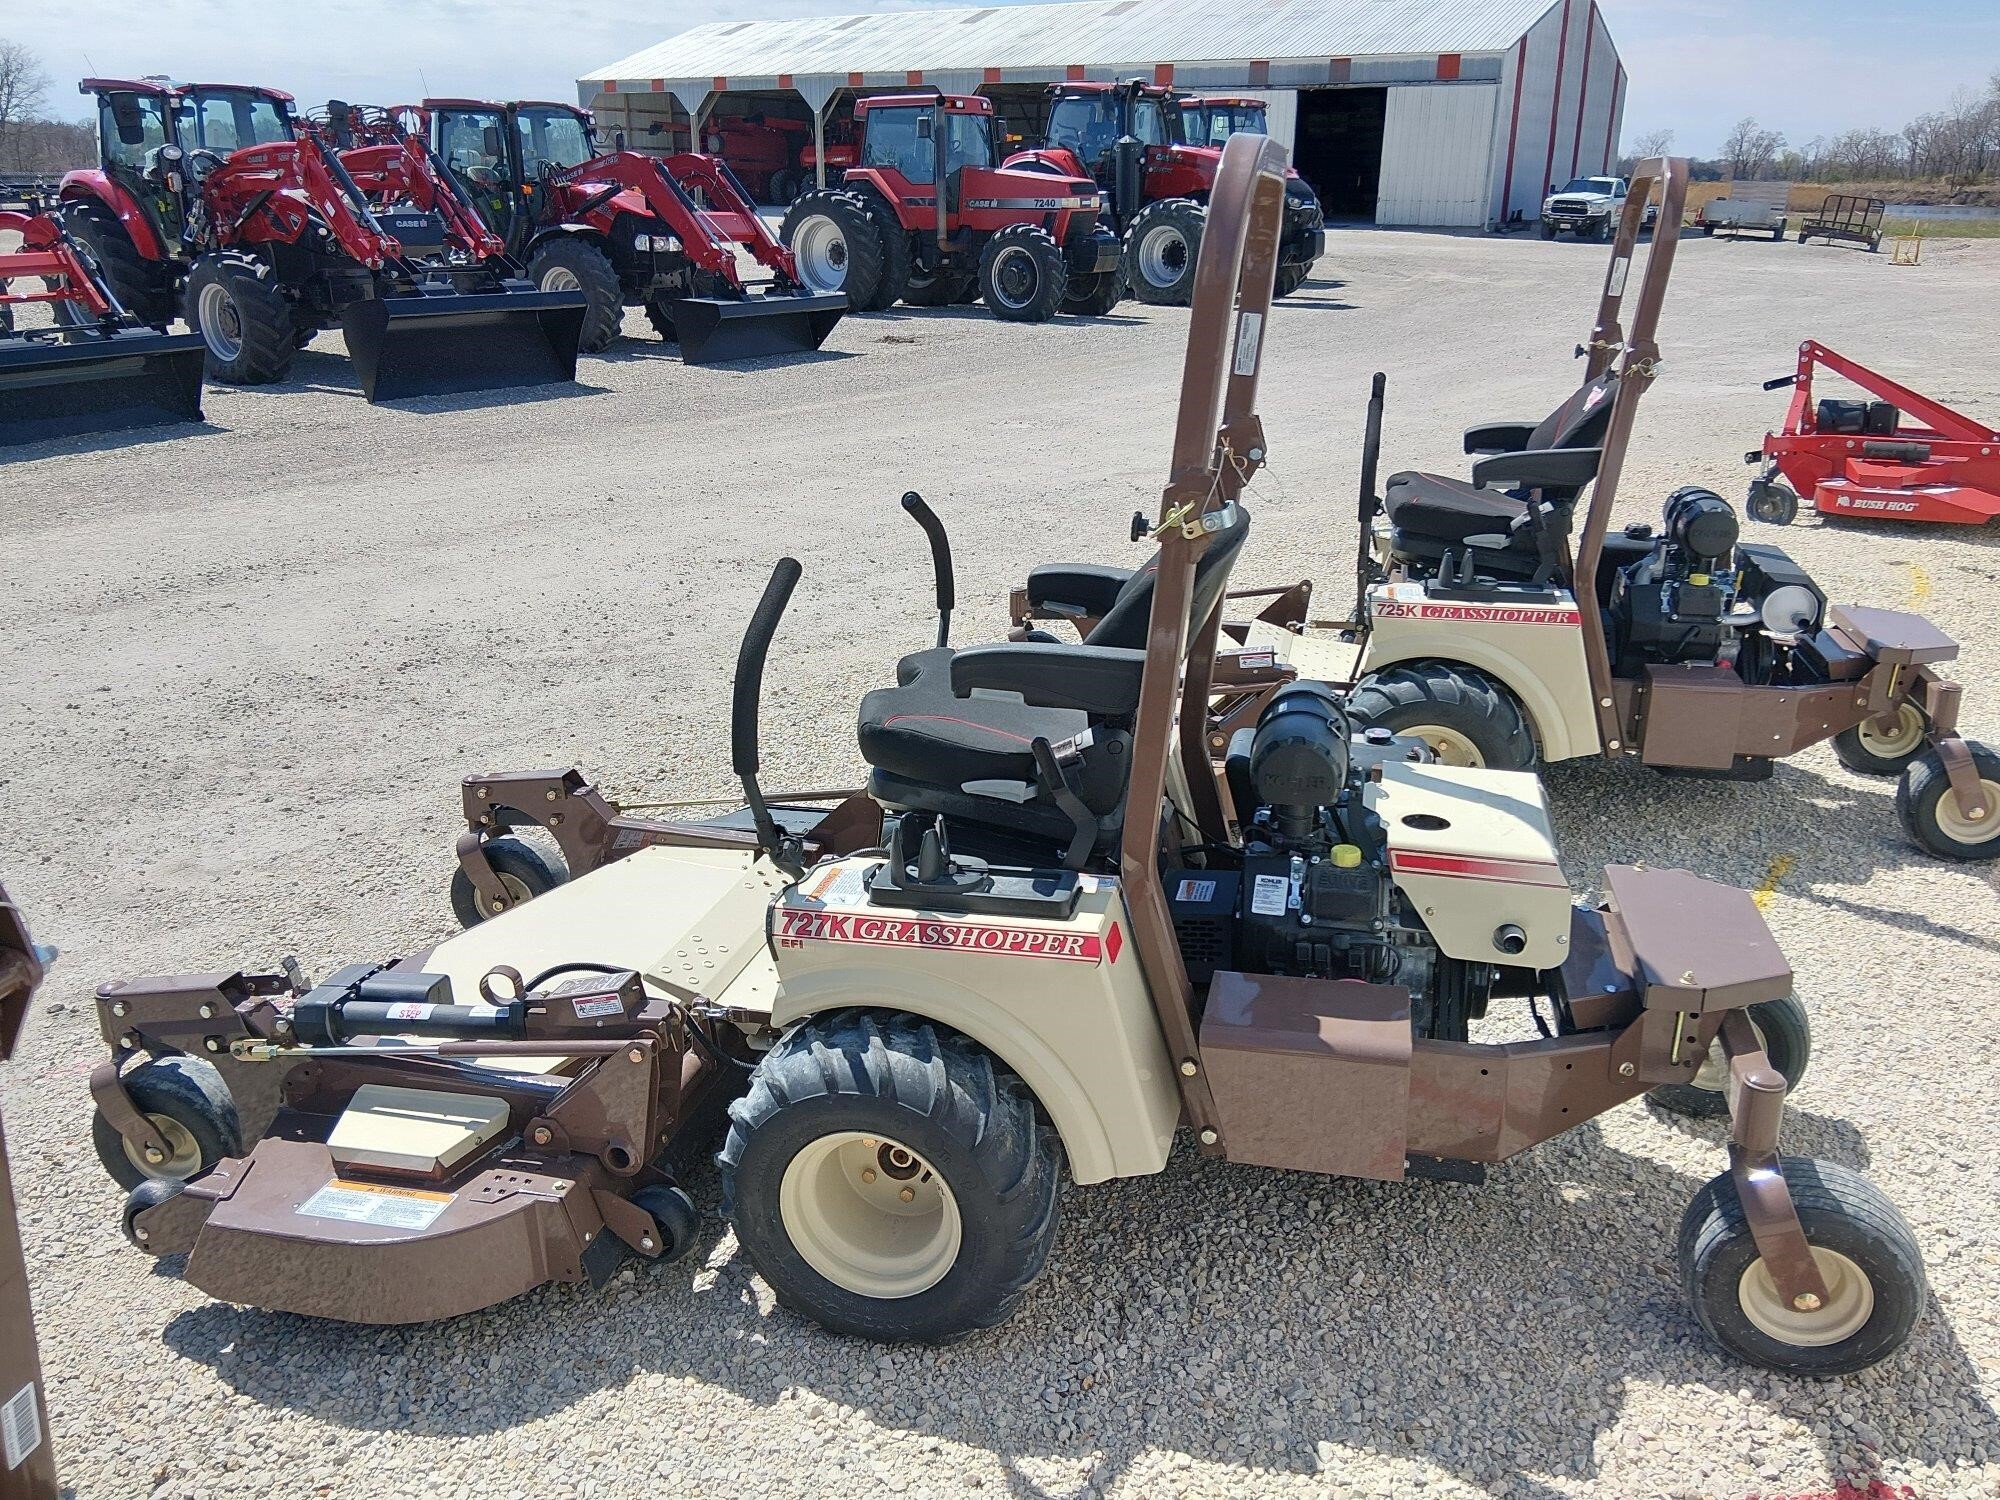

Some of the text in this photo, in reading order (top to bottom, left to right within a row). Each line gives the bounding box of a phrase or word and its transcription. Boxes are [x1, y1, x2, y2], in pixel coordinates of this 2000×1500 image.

[968, 199, 990, 208] CASE
[1034, 199, 1056, 208] 7240
[396, 220, 419, 228] CASE
[1852, 499, 1915, 512] BUSH HOG
[1377, 603, 1569, 624] 725K GRASSHOPPER
[781, 911, 1085, 956] 727K GRASSHOPPER
[781, 938, 804, 949] EFI
[398, 1009, 422, 1019] STEP
[379, 1187, 417, 1197] WARNING
